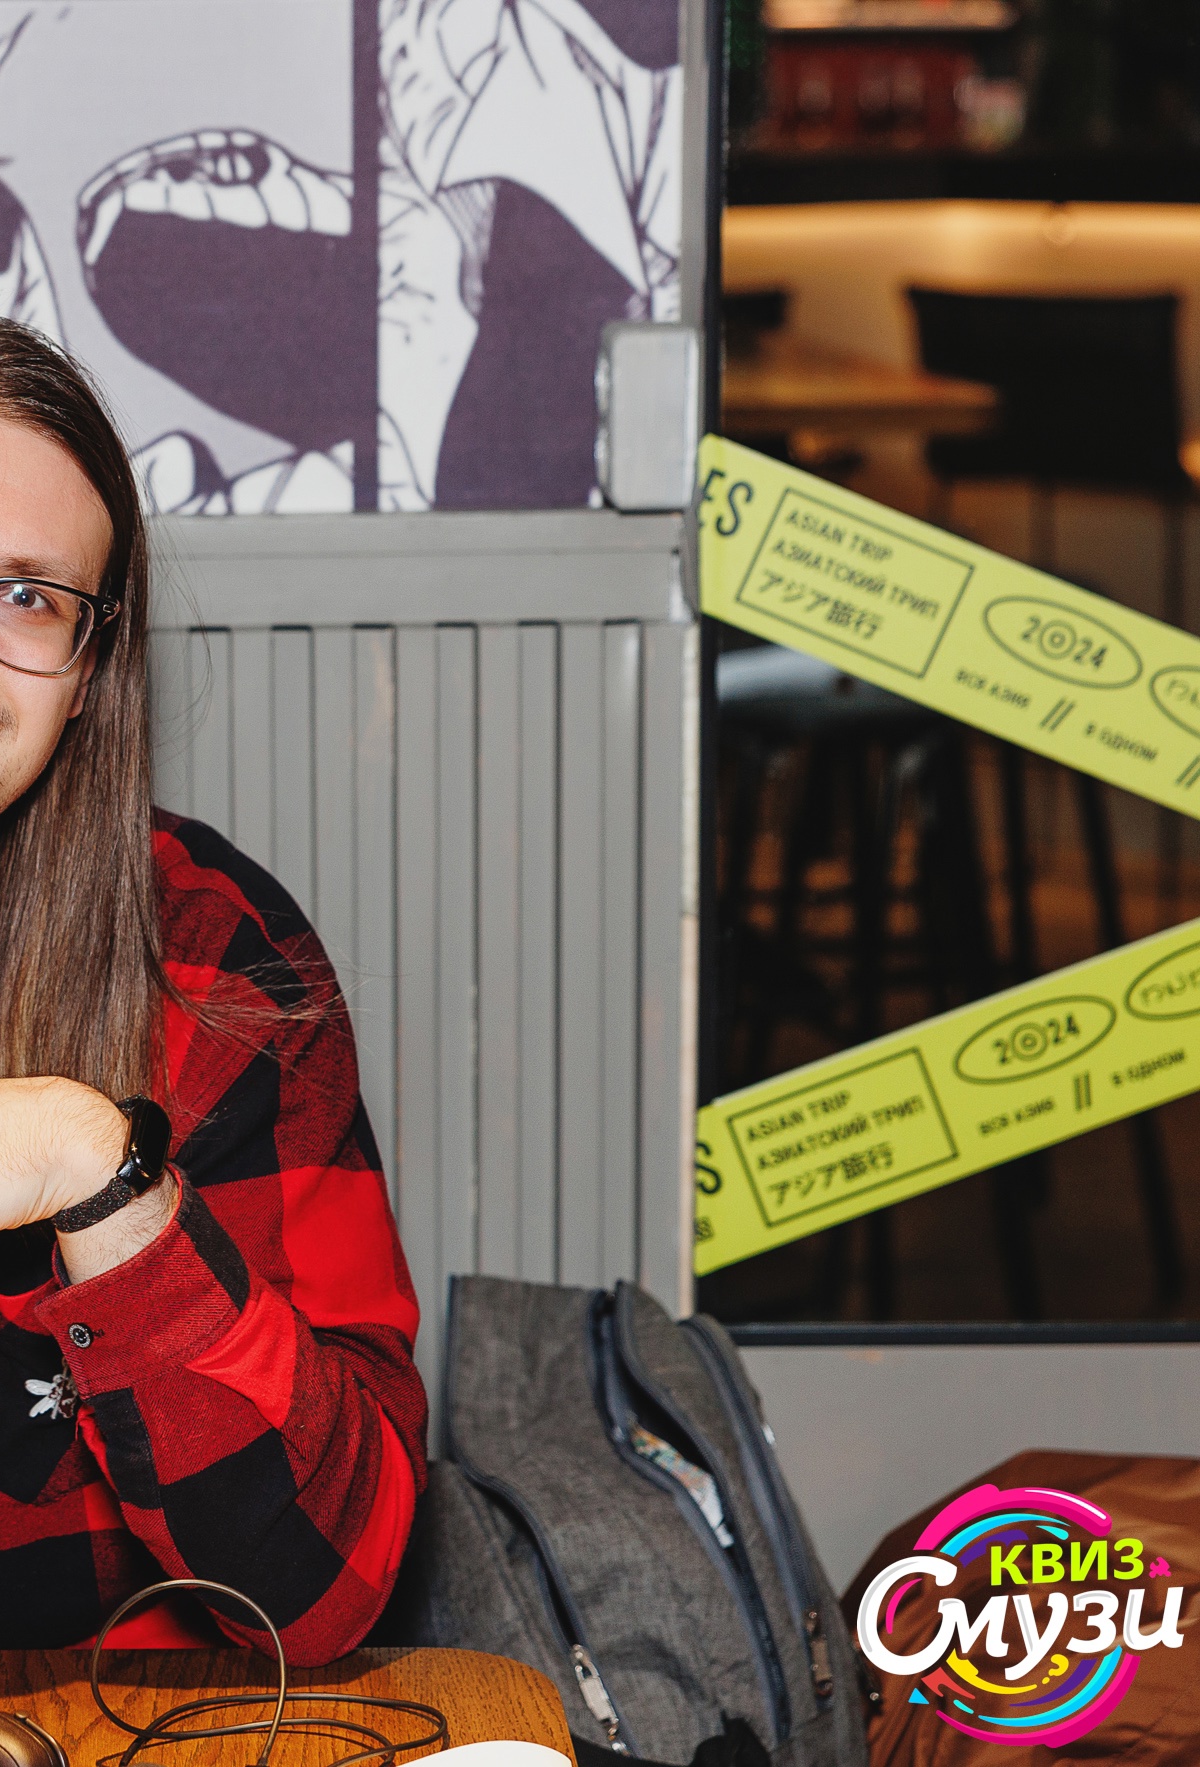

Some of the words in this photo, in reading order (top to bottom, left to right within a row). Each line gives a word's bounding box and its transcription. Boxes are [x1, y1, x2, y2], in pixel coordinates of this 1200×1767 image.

[786, 509, 847, 544] ASIAN
[849, 532, 893, 562] TRIP
[758, 568, 885, 640] アジア旅行
[772, 538, 888, 596] АЗИАТСКИЙ
[890, 584, 942, 620] ТРИП
[746, 1109, 804, 1142] ASIAN
[807, 1089, 851, 1119] TRIP
[757, 1112, 869, 1171] АЗИАТСКИЙ
[871, 1094, 925, 1128] ТРИП
[768, 1141, 895, 1207] アジア旅行
